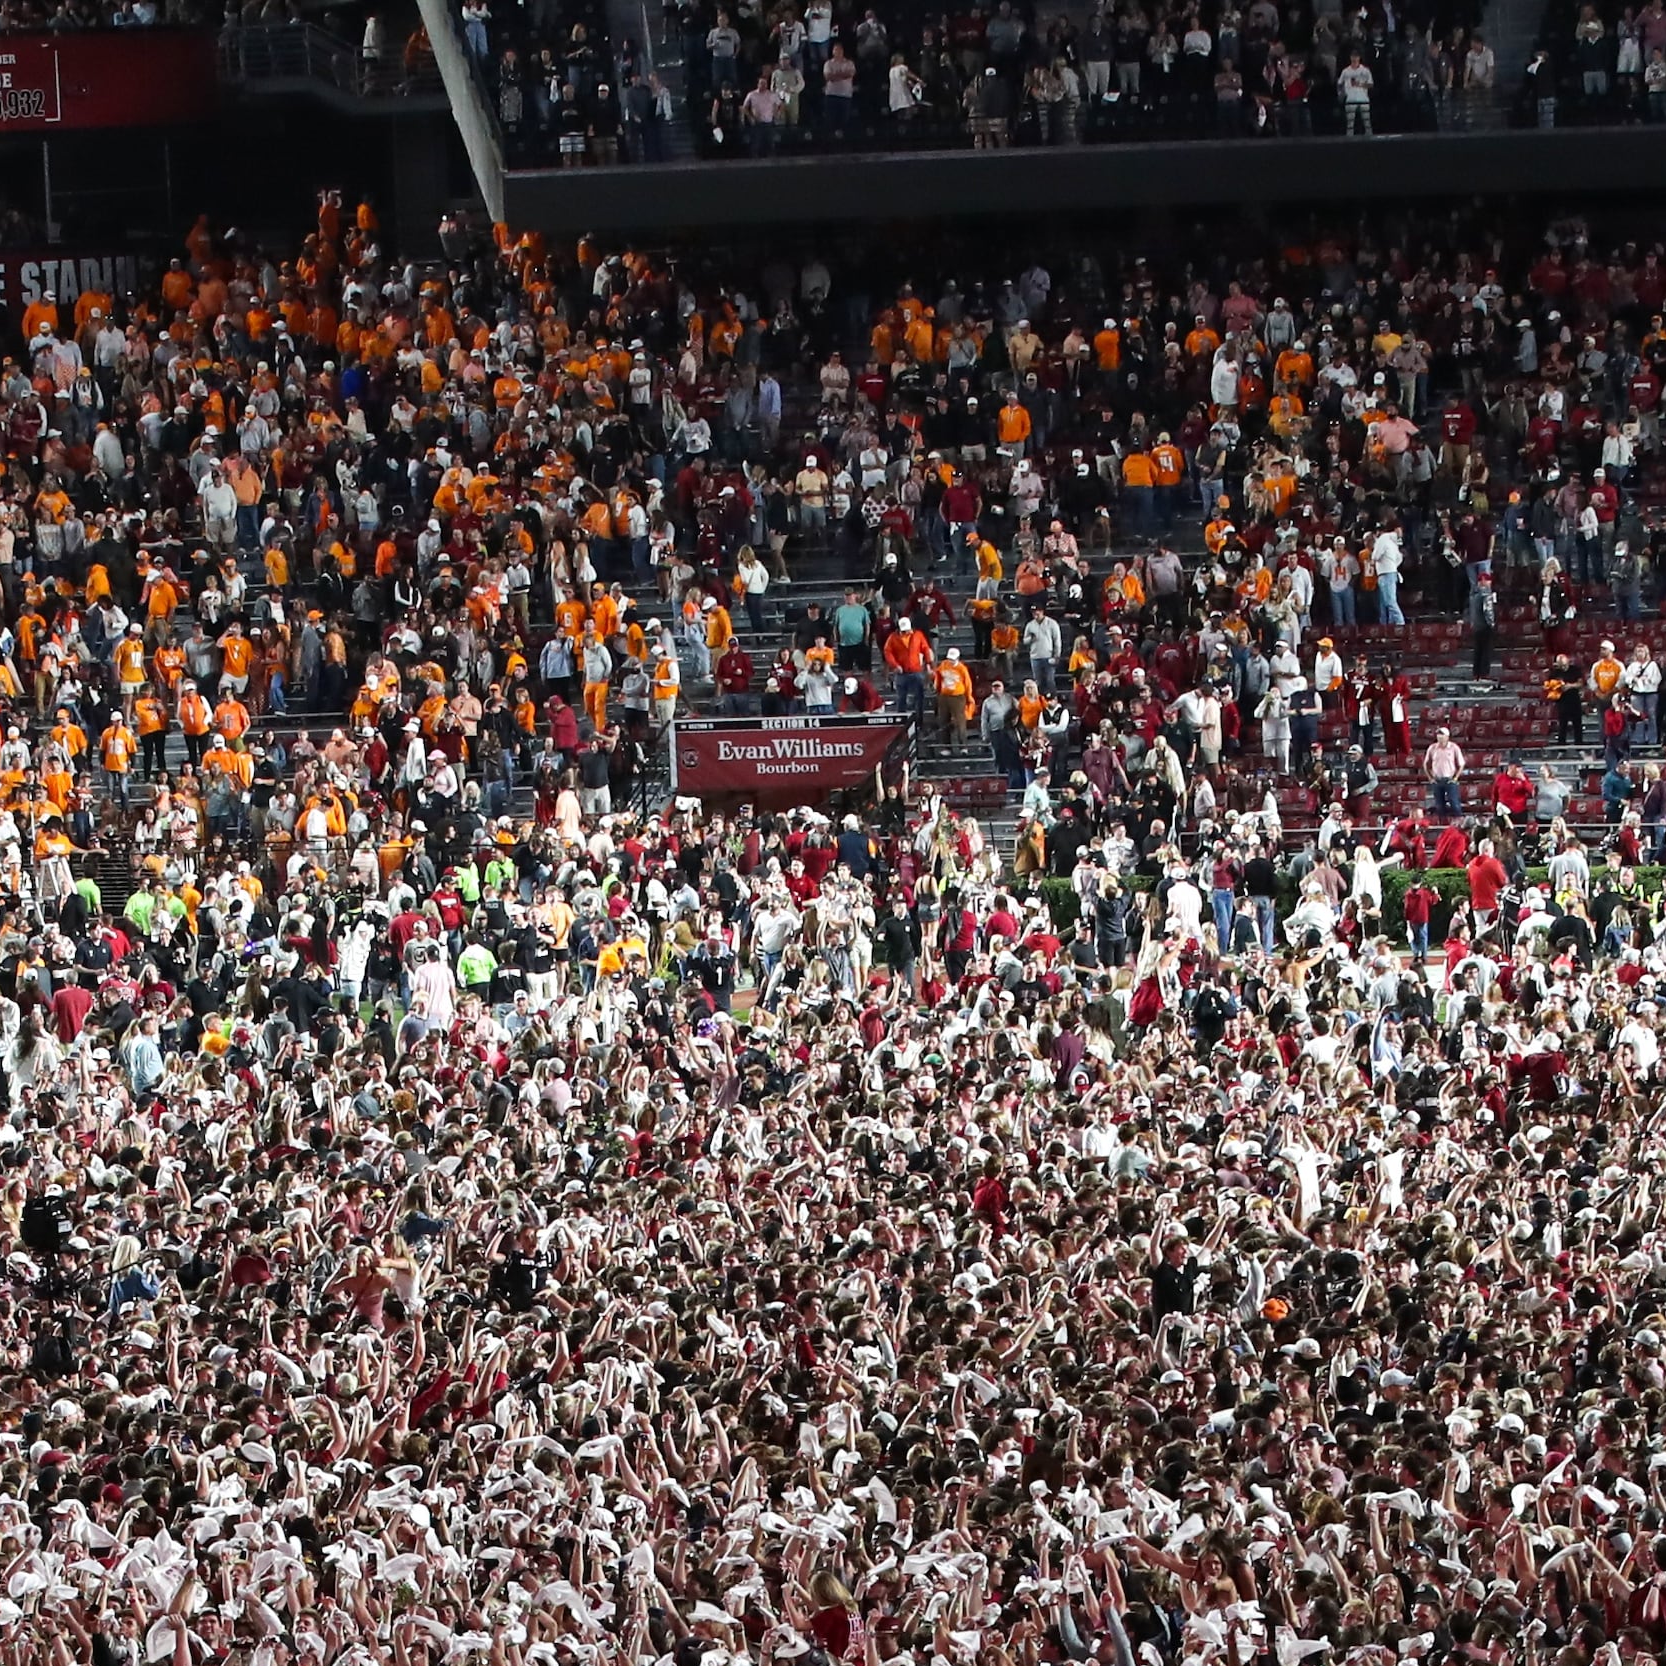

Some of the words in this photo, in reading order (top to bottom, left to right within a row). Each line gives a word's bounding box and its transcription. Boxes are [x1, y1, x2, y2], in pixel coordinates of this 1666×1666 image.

[20, 256, 138, 307] STADIU
[1355, 684, 1364, 700] 7
[761, 719, 801, 730] SECTION
[803, 718, 821, 729] 14
[756, 762, 819, 775] Bourbon
[717, 967, 723, 986] 1
[530, 1269, 537, 1290] 1
